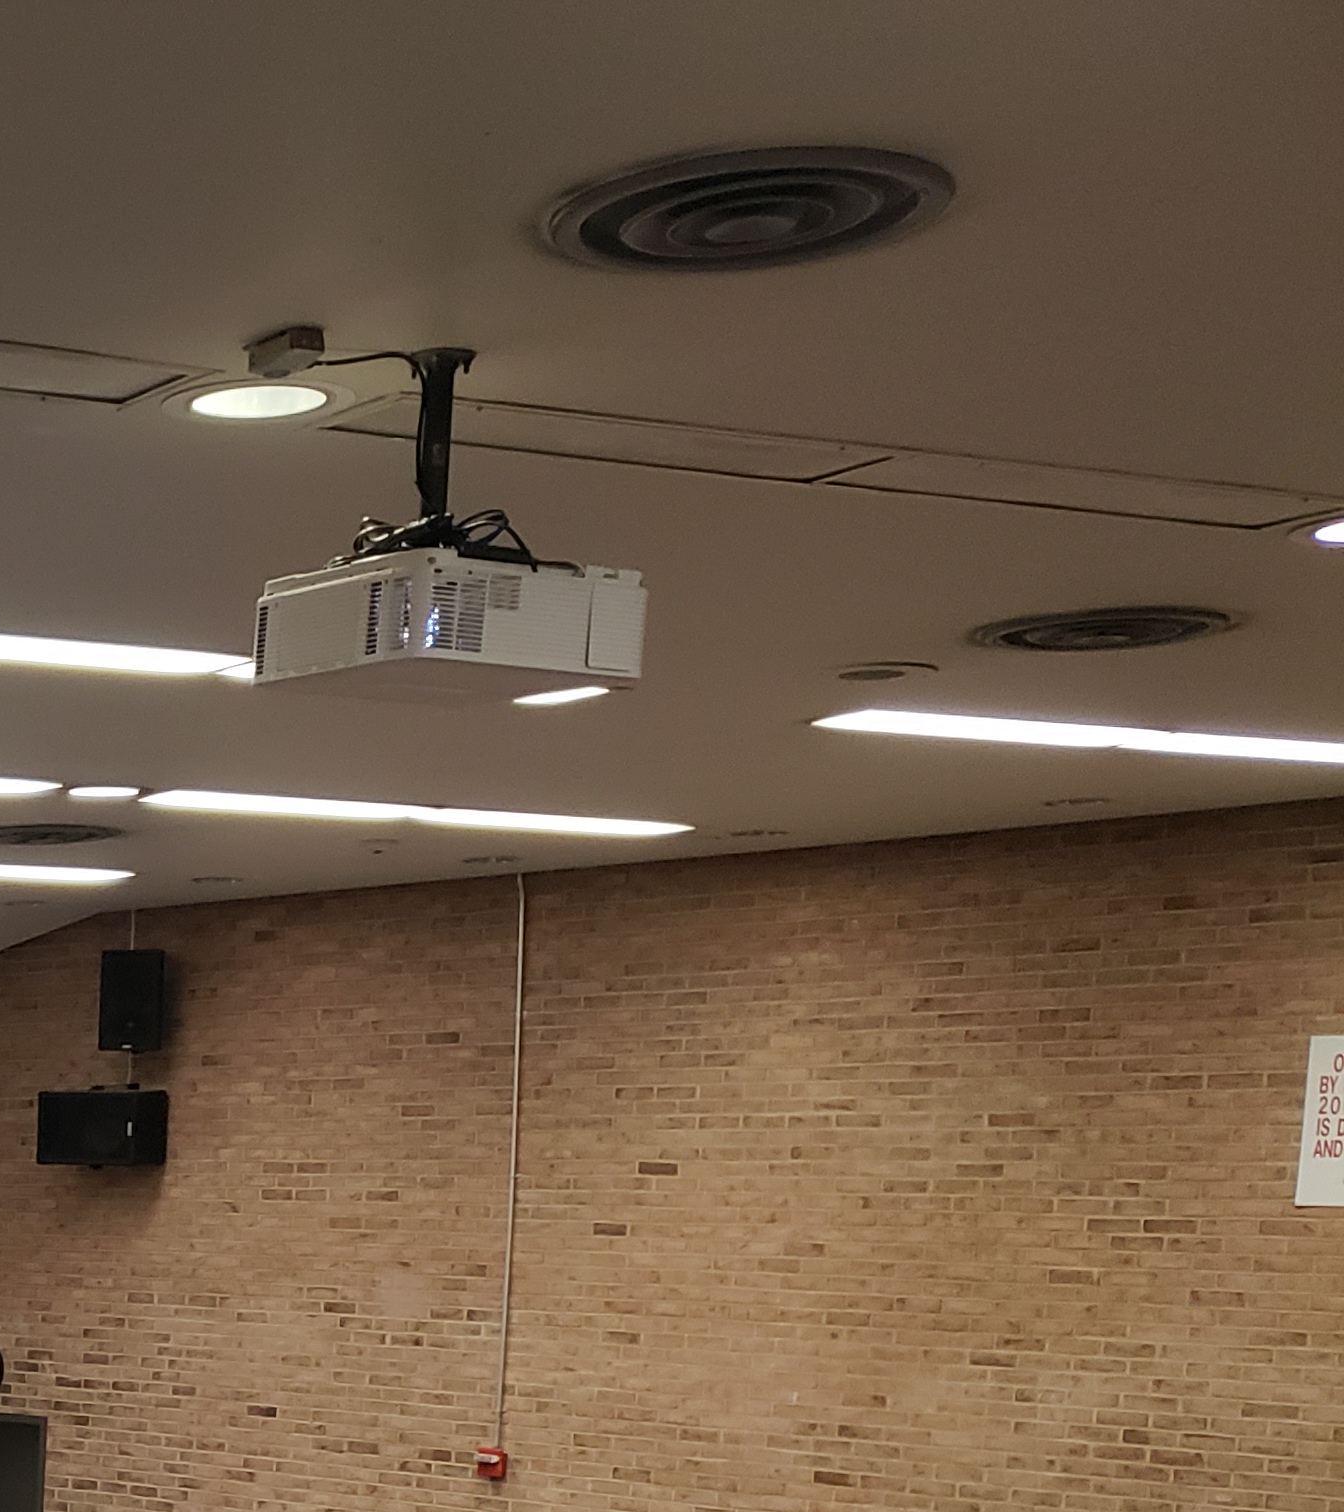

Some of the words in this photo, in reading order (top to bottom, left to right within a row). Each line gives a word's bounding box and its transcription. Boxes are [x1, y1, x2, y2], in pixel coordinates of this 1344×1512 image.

[1319, 1076, 1339, 1094] BY
[1316, 1118, 1331, 1137] IS
[1313, 1140, 1343, 1158] AND
